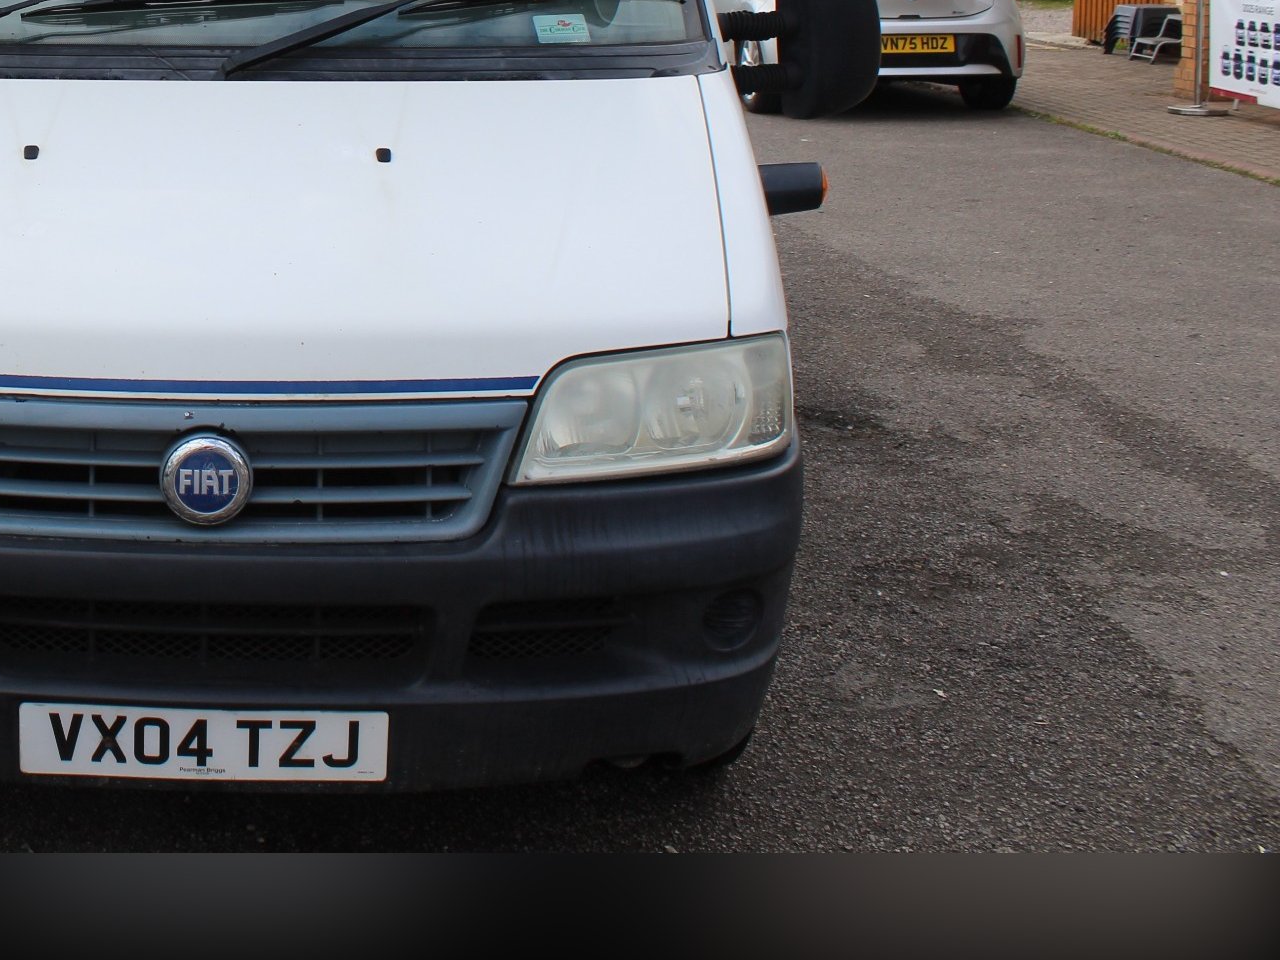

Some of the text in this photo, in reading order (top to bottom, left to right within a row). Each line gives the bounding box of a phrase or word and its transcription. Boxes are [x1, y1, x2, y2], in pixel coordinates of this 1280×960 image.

[882, 36, 949, 50] VN75 HDZ
[179, 468, 234, 496] FIAT
[48, 712, 360, 769] VX04 TZJ
